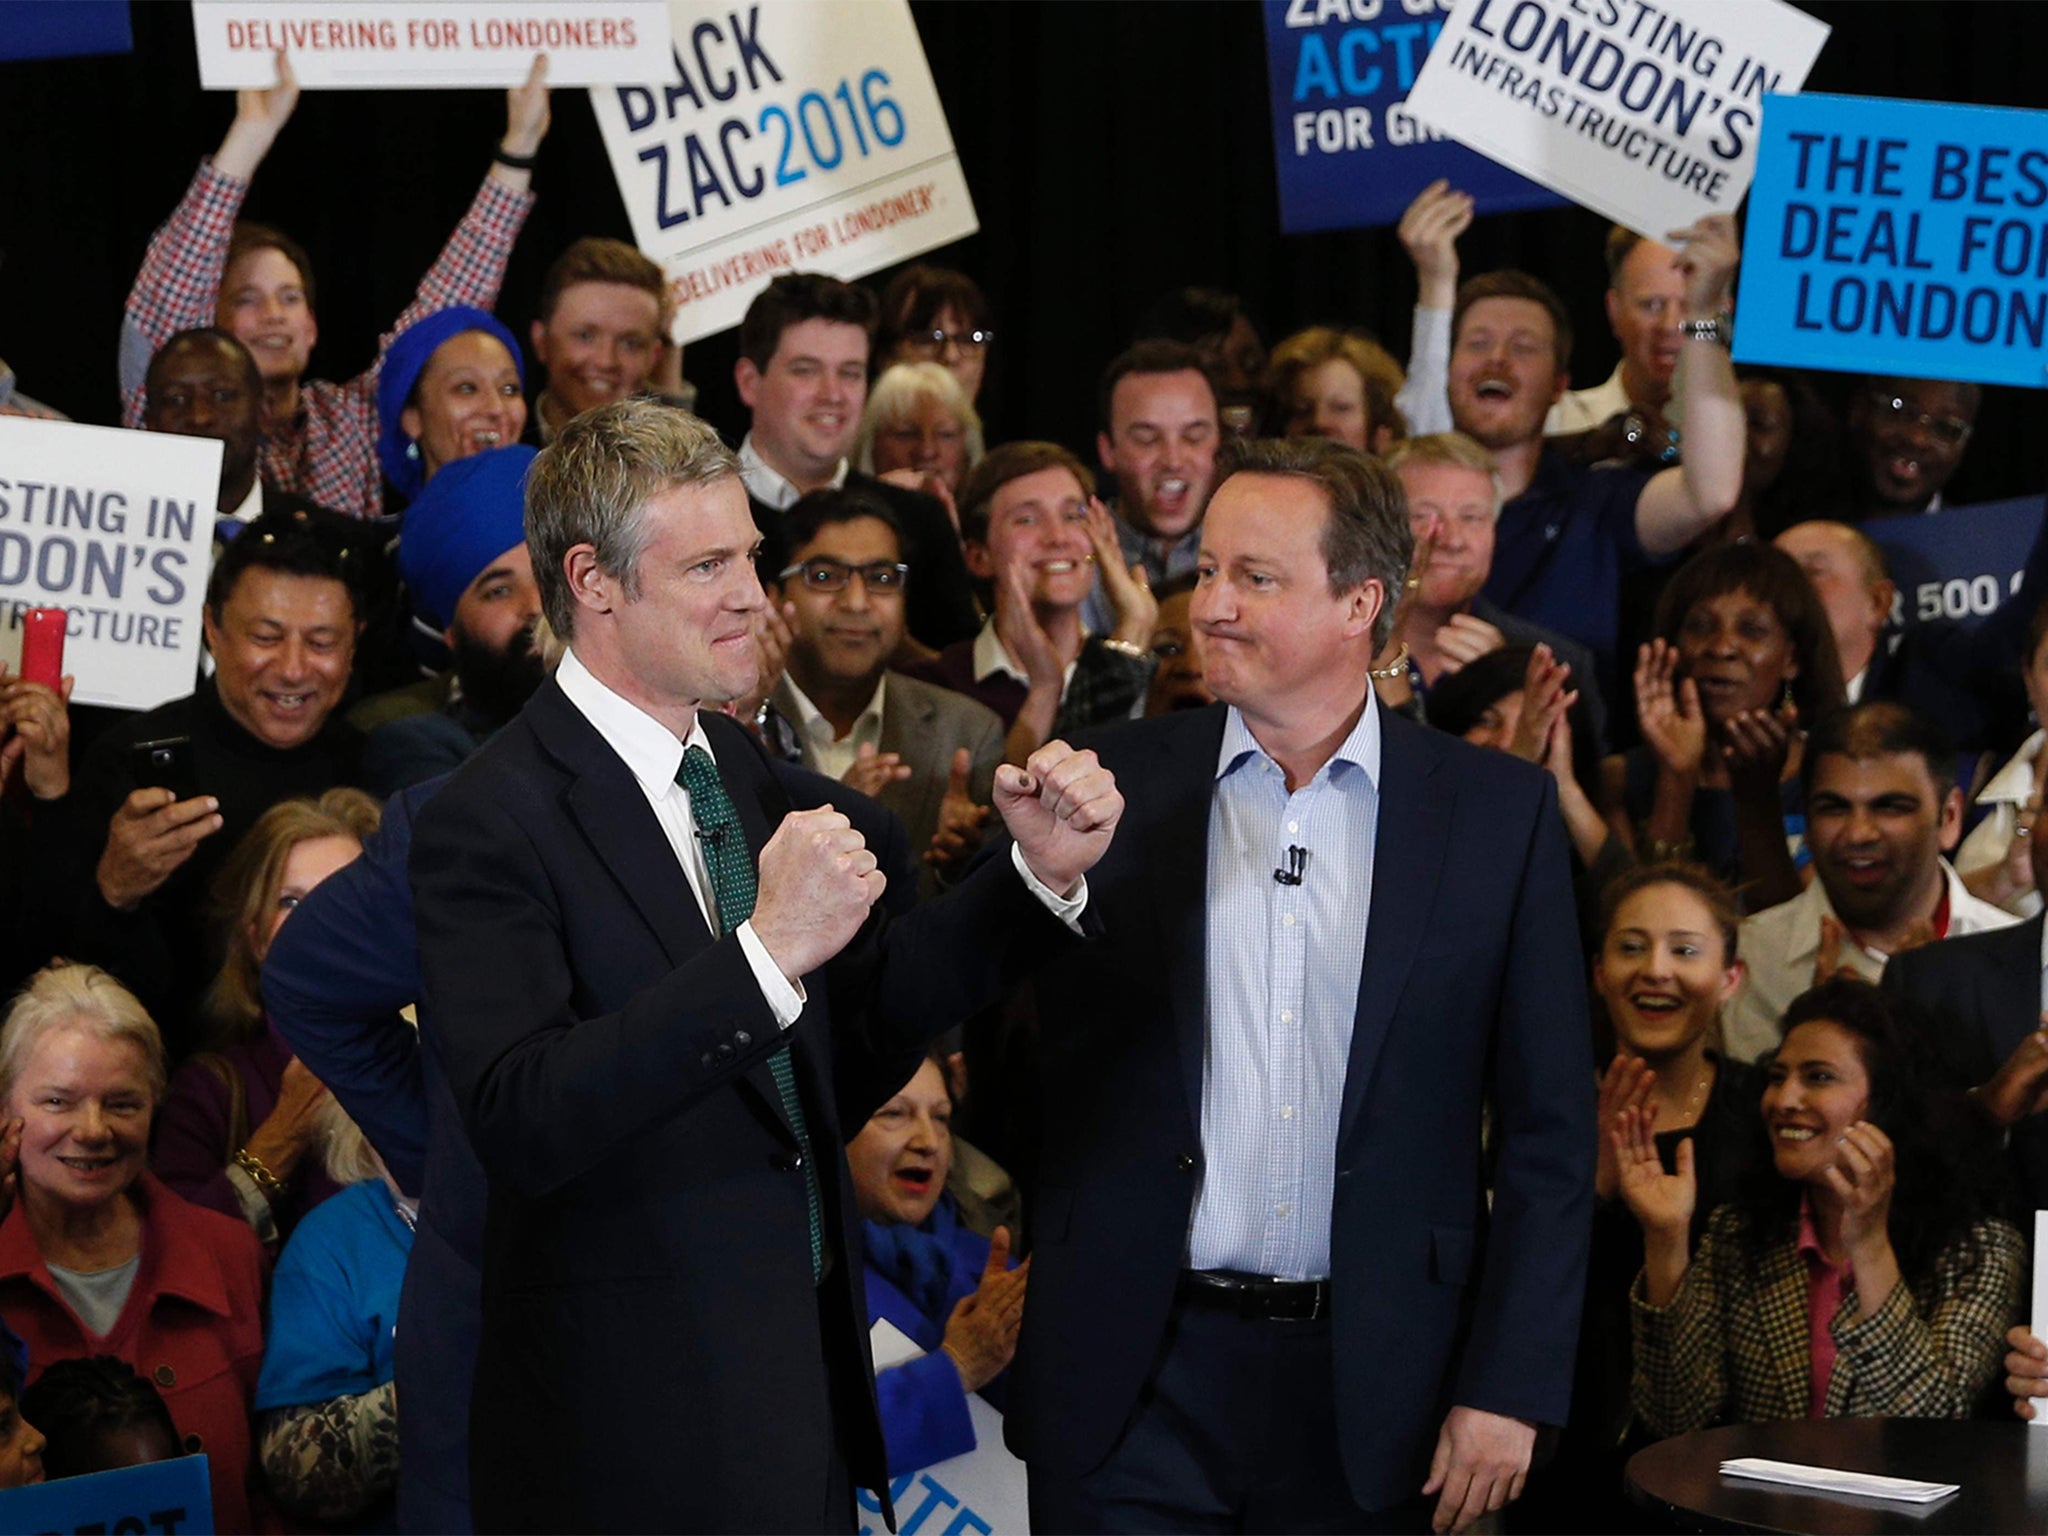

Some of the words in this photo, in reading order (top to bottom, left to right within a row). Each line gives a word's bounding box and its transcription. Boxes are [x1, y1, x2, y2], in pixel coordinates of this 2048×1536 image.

[227, 18, 396, 50] DELIVERING
[408, 18, 459, 48] FOR
[471, 18, 638, 49] LONDONERS
[1470, 0, 1754, 161] LONDON'S
[1731, 57, 1781, 98] IN
[1293, 106, 1374, 154] FOR
[1451, 40, 1730, 203] INFRASTRUCTURE
[1788, 131, 1908, 197] THE
[674, 237, 791, 305] DELIVERING
[794, 223, 833, 259] FOR
[834, 182, 936, 244] LONDONER
[1781, 203, 1933, 271] DEAL
[1794, 272, 2048, 350] LONDON
[147, 496, 196, 541] IN
[1916, 574, 2000, 622] 500
